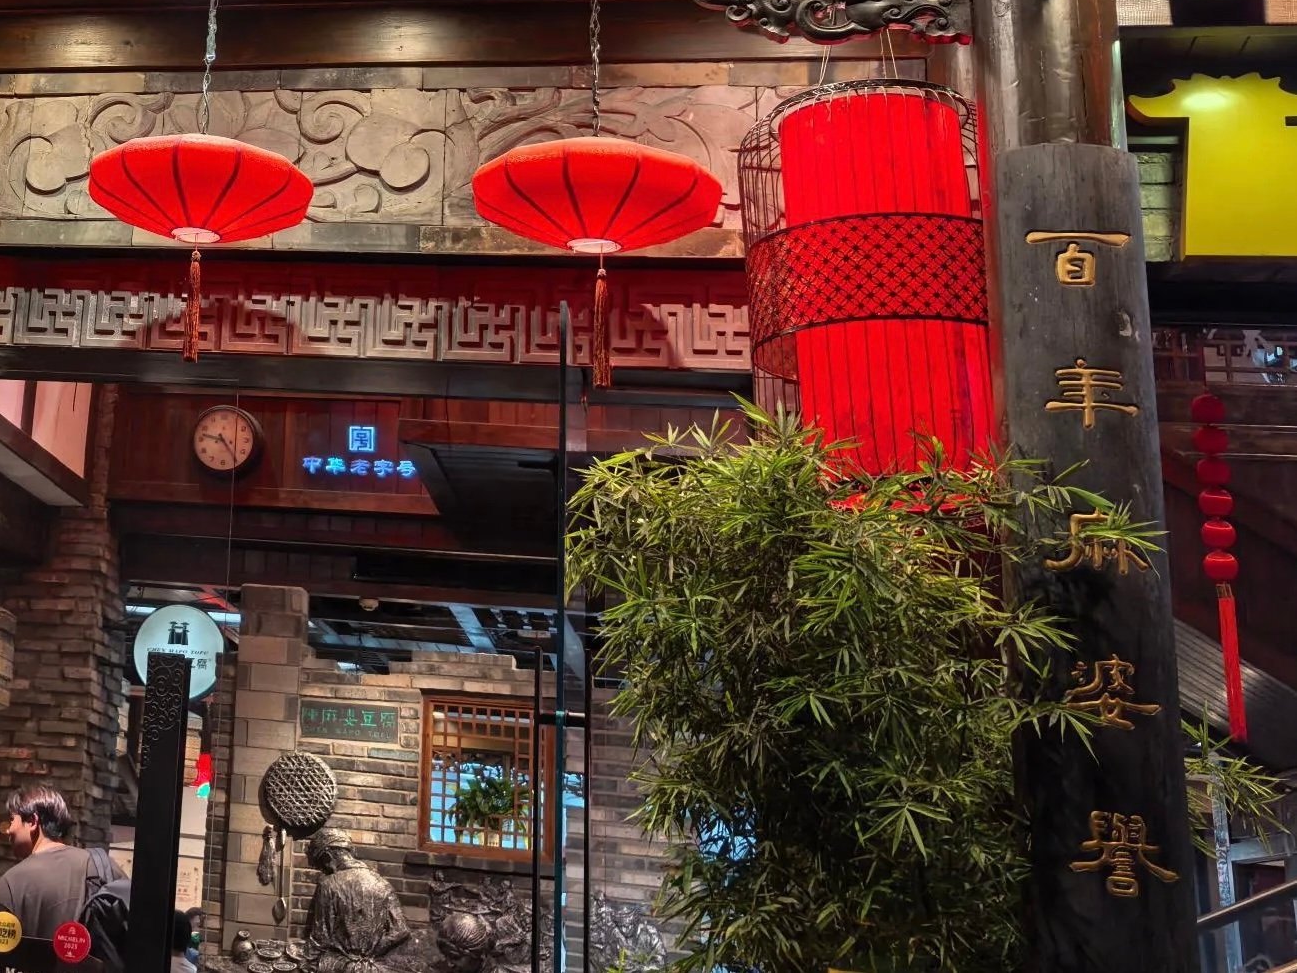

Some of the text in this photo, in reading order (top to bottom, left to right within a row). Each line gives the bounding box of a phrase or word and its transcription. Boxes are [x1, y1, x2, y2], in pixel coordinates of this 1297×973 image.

[303, 456, 416, 477] 中华老字号
